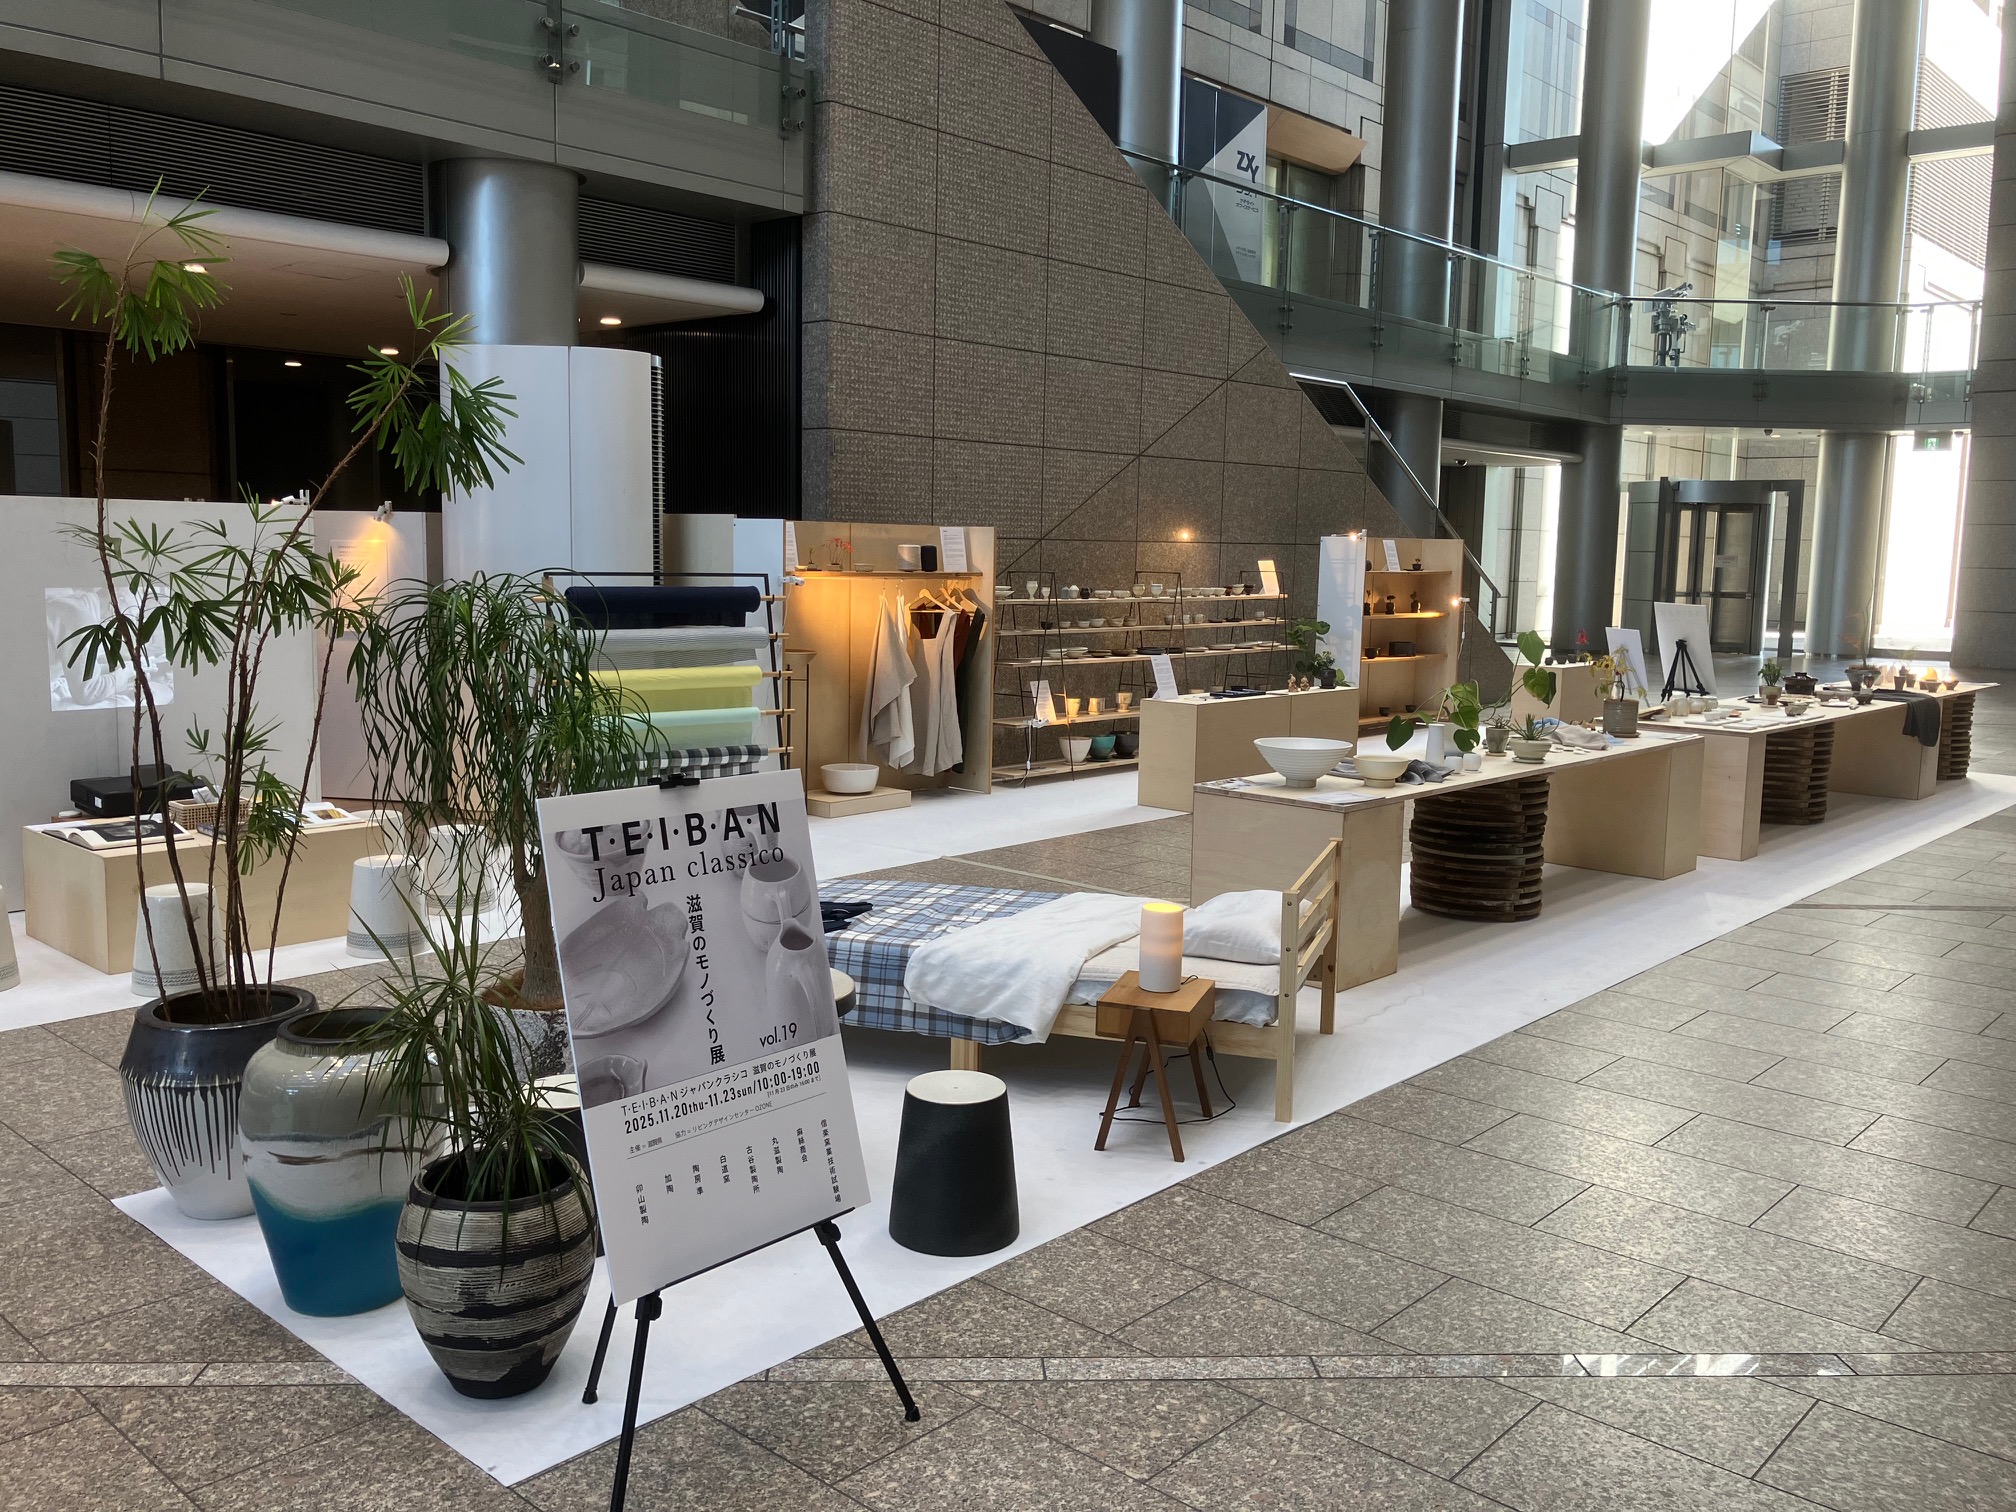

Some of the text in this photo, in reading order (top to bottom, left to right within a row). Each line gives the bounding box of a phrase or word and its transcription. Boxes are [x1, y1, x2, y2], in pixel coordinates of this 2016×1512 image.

[1236, 150, 1260, 184] ZXY
[592, 842, 785, 903] Japan classico
[686, 894, 727, 1066] 滋賀のモノづくり展
[759, 1022, 798, 1048] vol.19
[752, 1048, 818, 1077] 滋賀のモノづくり展
[745, 1145, 761, 1194] 古谷製陶所
